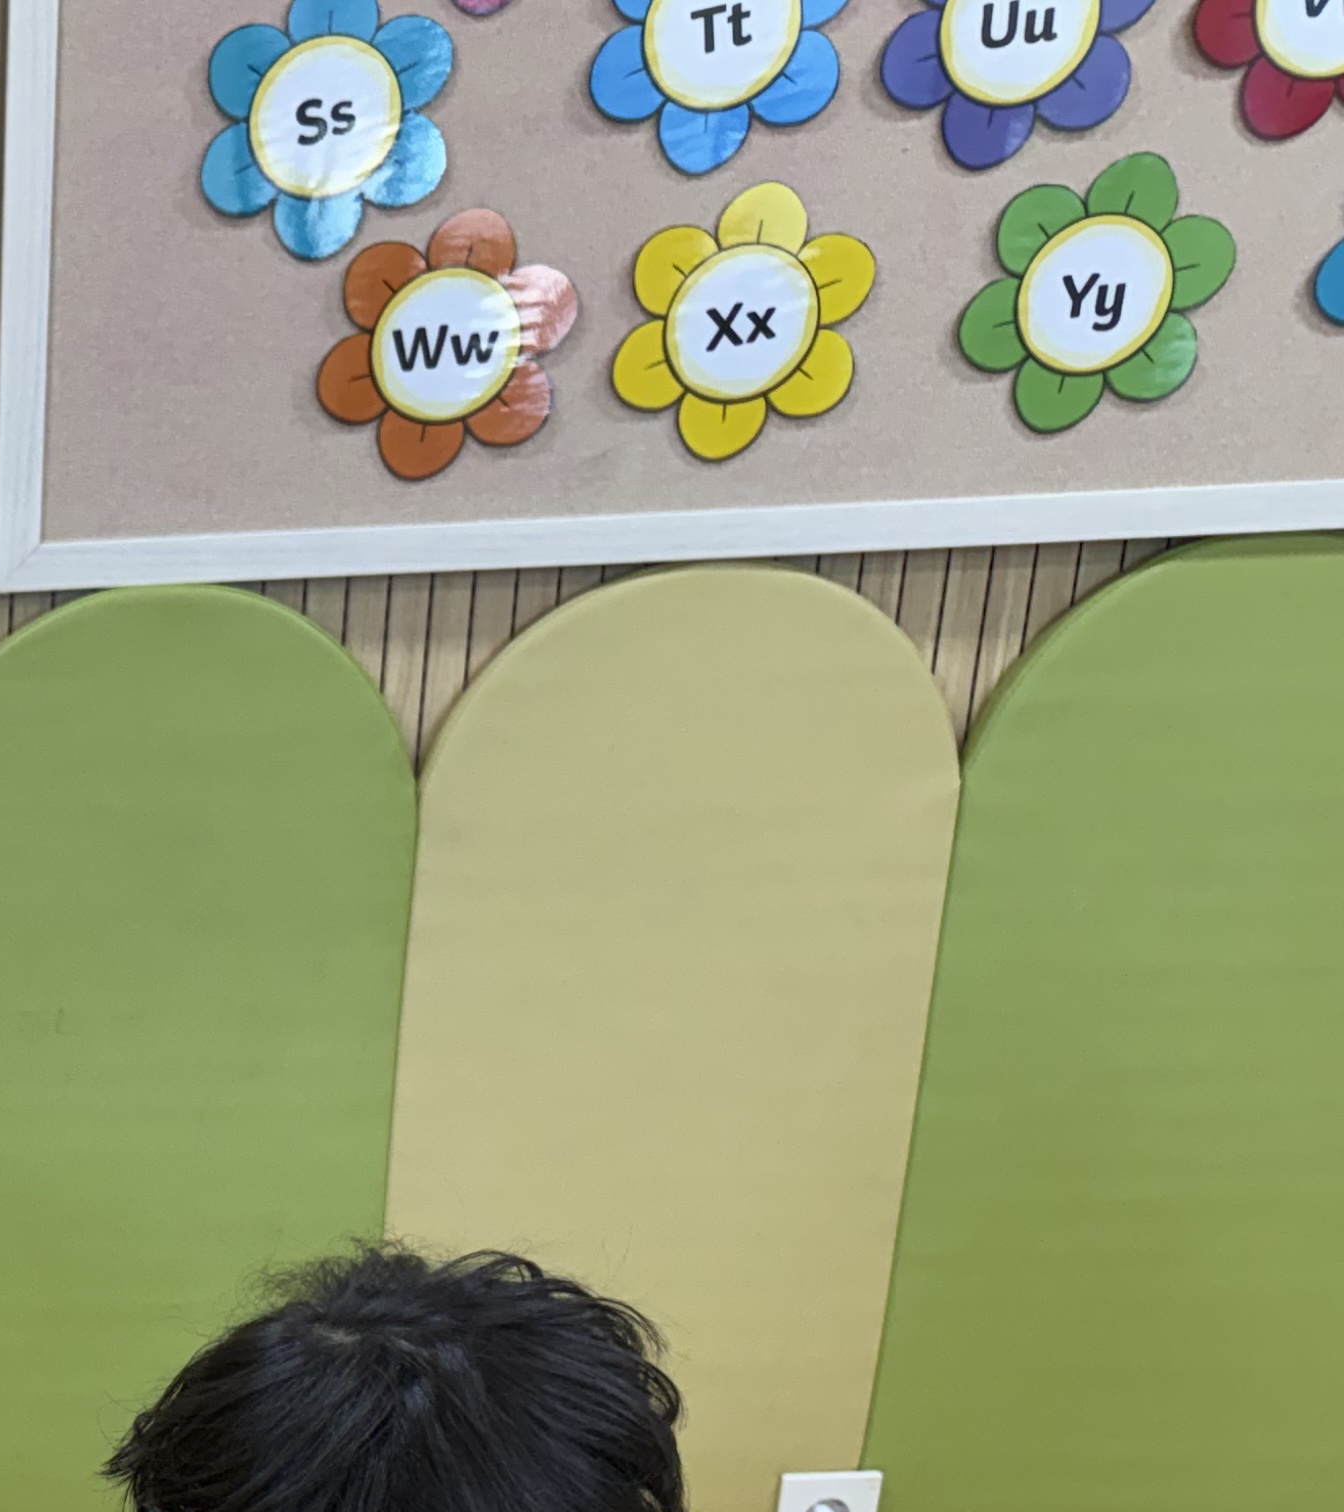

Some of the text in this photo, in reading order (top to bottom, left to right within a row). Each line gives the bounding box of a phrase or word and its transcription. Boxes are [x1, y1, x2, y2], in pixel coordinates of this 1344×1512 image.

[690, 3, 752, 54] Tt
[981, 2, 1057, 49] Uu
[295, 98, 356, 147] Ss
[705, 302, 776, 351] Xx
[1063, 273, 1126, 331] Yy
[392, 324, 499, 372] Ww
